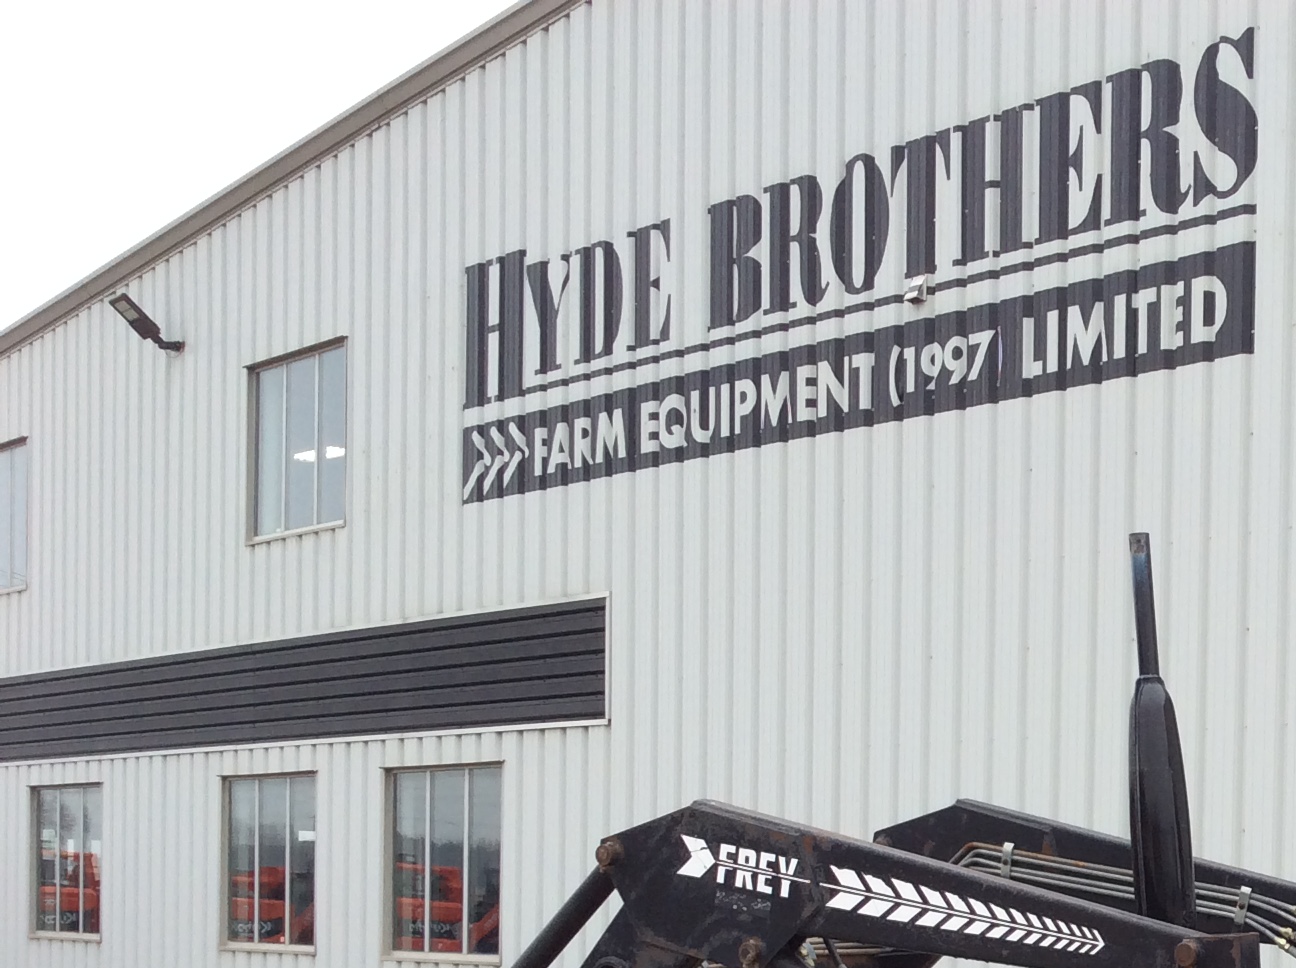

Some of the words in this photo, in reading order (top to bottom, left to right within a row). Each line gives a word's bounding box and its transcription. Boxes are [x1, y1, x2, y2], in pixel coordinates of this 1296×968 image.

[463, 218, 671, 411] HYDE
[707, 27, 1258, 333] BROTHERS
[534, 408, 627, 476] FARM
[640, 352, 875, 449] EQUIPMENT
[1023, 276, 1228, 379] LIMITED
[716, 843, 799, 898] FREY
